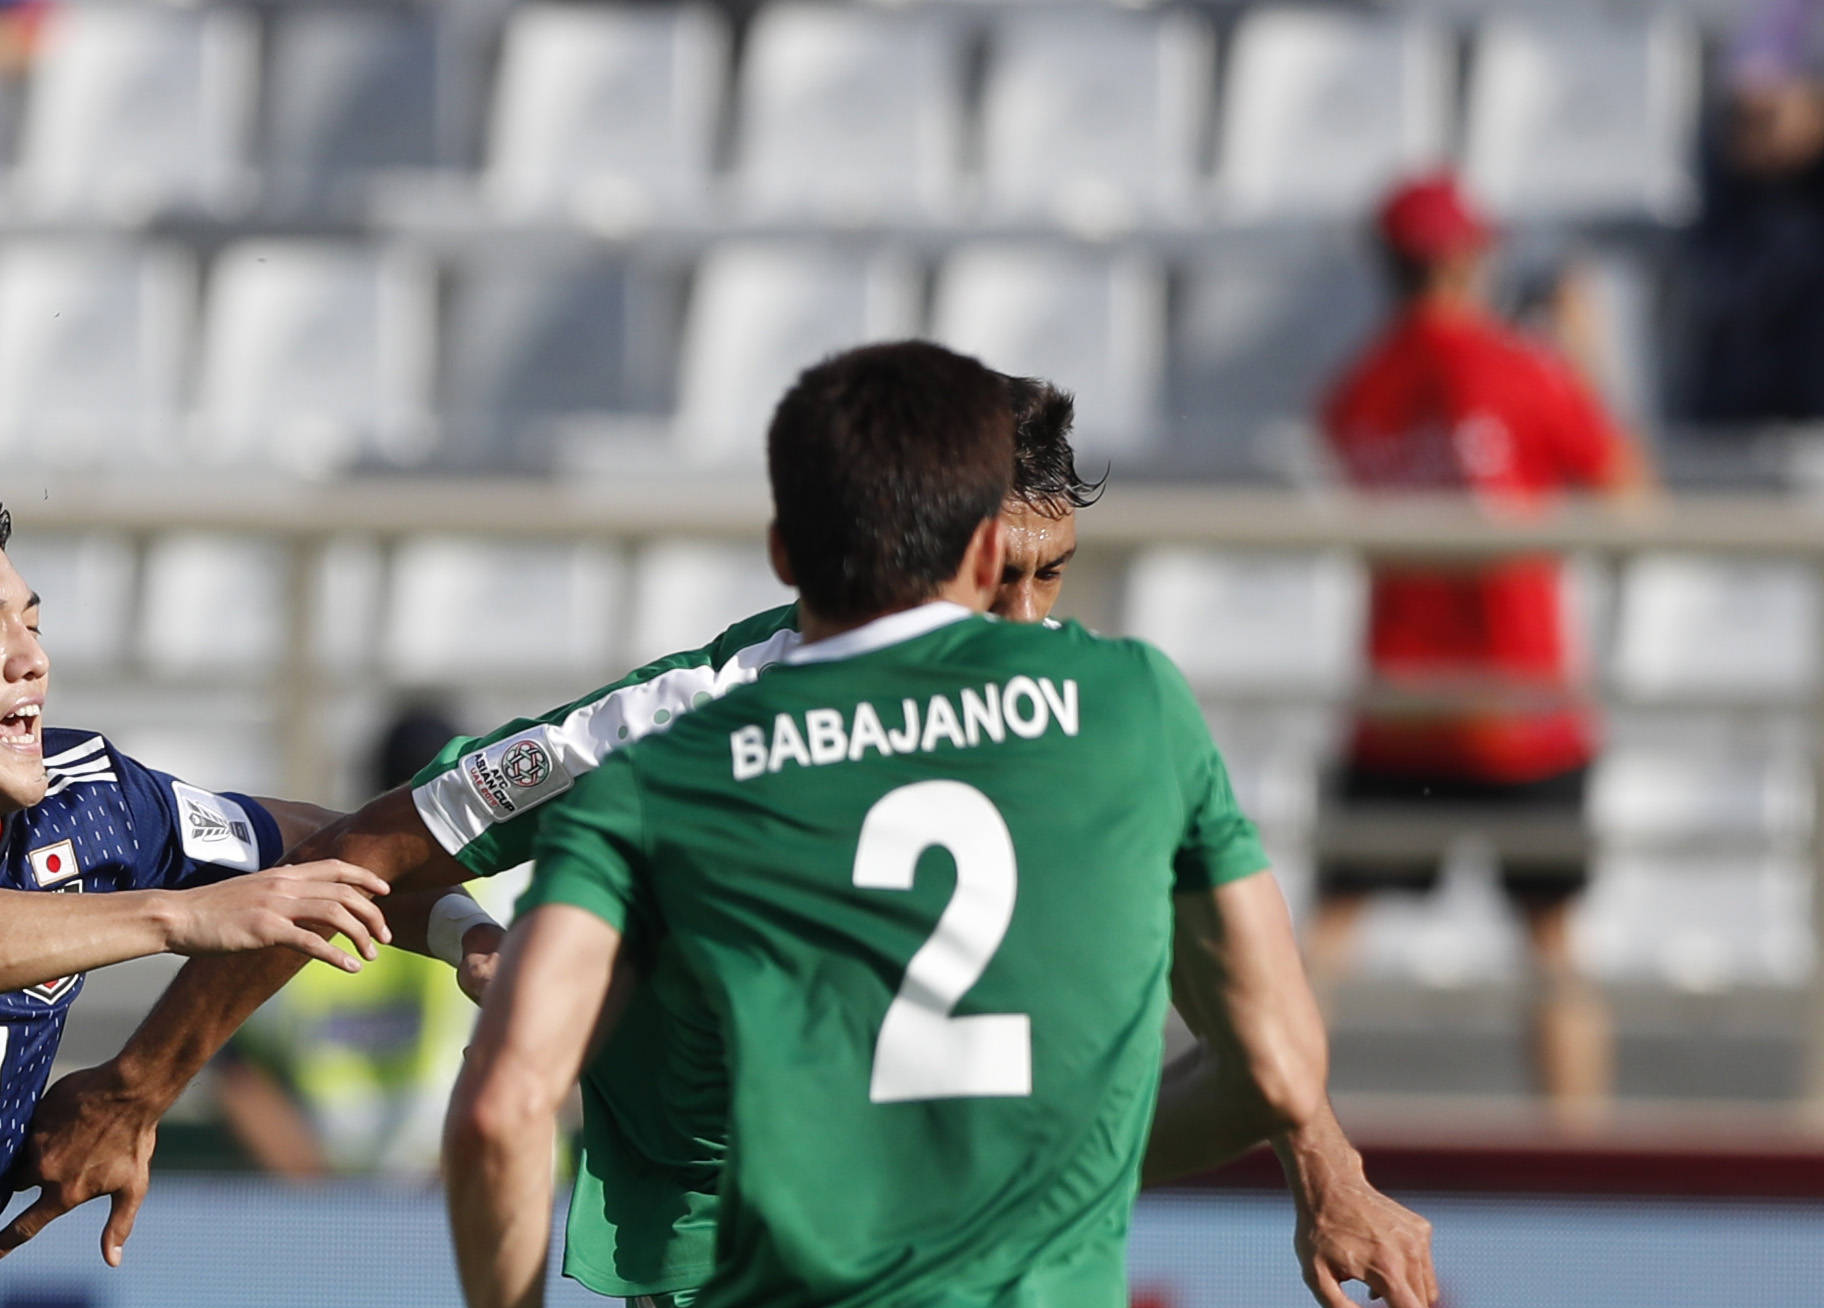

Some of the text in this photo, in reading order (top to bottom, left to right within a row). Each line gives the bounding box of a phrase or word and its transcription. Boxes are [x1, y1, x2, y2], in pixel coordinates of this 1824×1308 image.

[731, 676, 1079, 781] BABAJANOV
[475, 753, 515, 812] ASIAN CUP
[490, 768, 509, 789] AFC
[852, 779, 1032, 1102] 2
